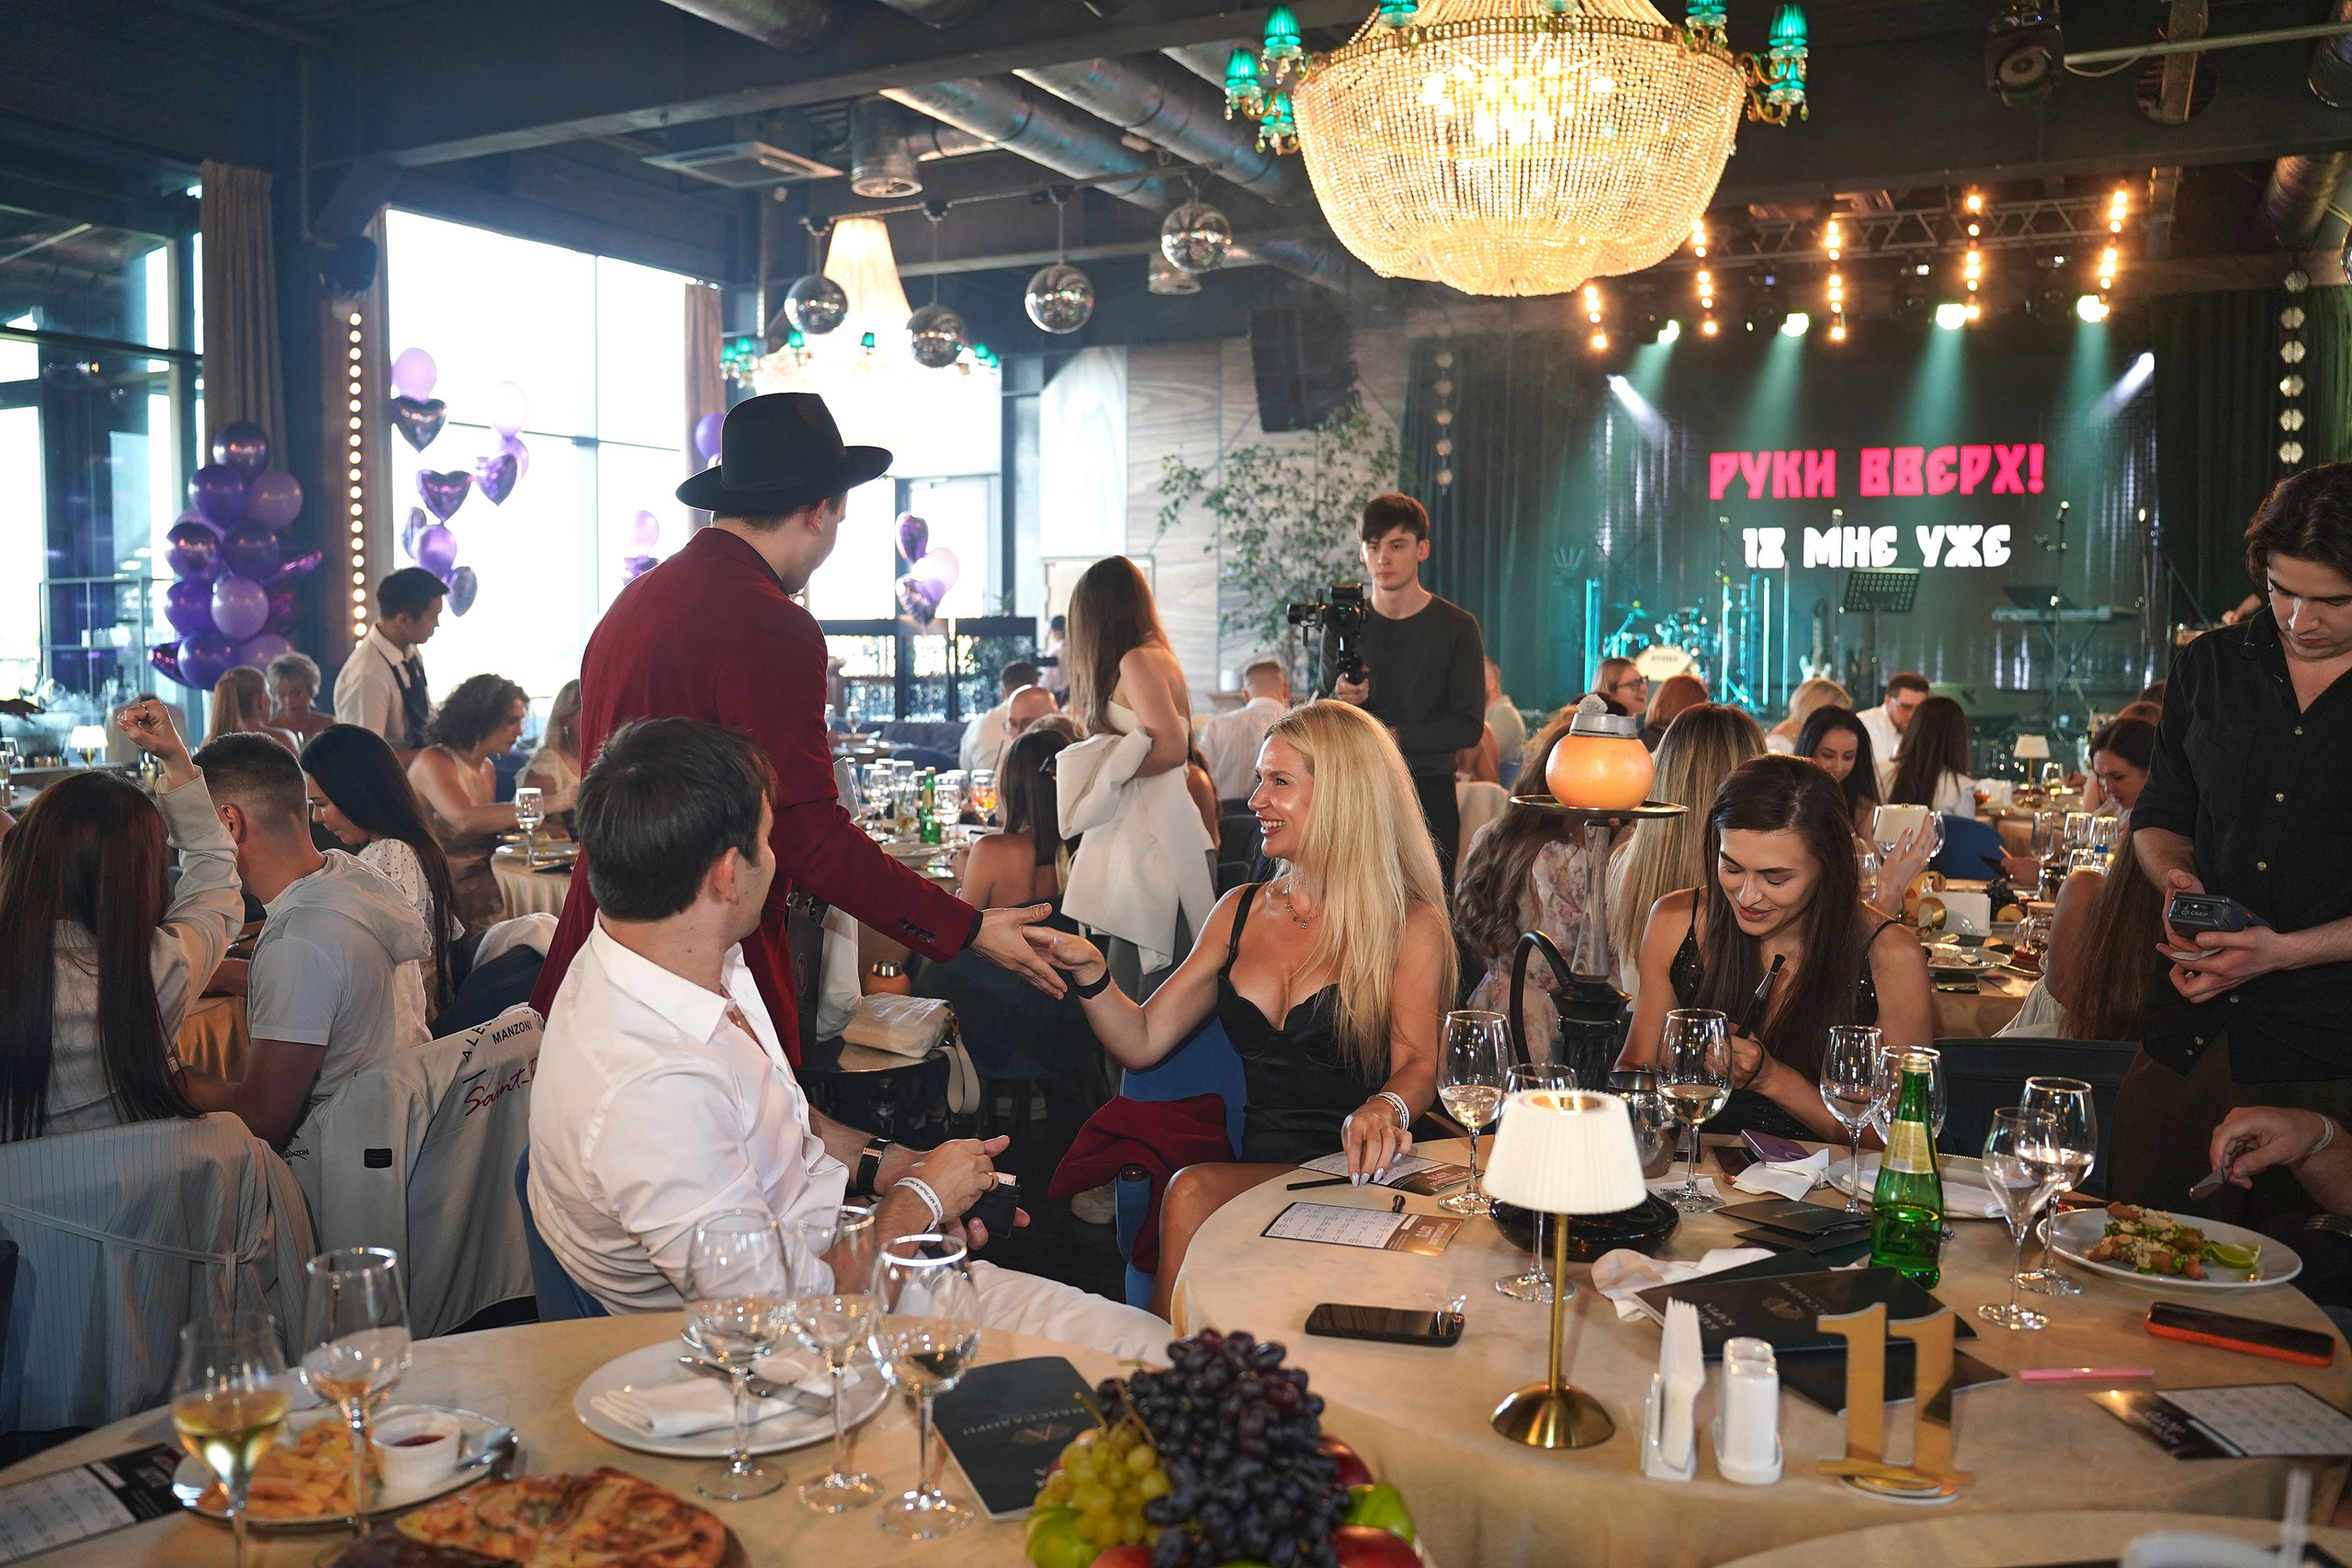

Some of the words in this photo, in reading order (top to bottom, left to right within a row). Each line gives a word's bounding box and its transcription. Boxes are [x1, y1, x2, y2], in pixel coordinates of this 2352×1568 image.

[1710, 449, 1836, 500] РУКИ
[1860, 444, 2044, 497] ВВЕРХ!
[1743, 527, 1786, 569] 18
[1804, 525, 1897, 569] МНЕ
[1916, 525, 2011, 568] УЖЕ
[492, 1020, 533, 1044] MANZONI
